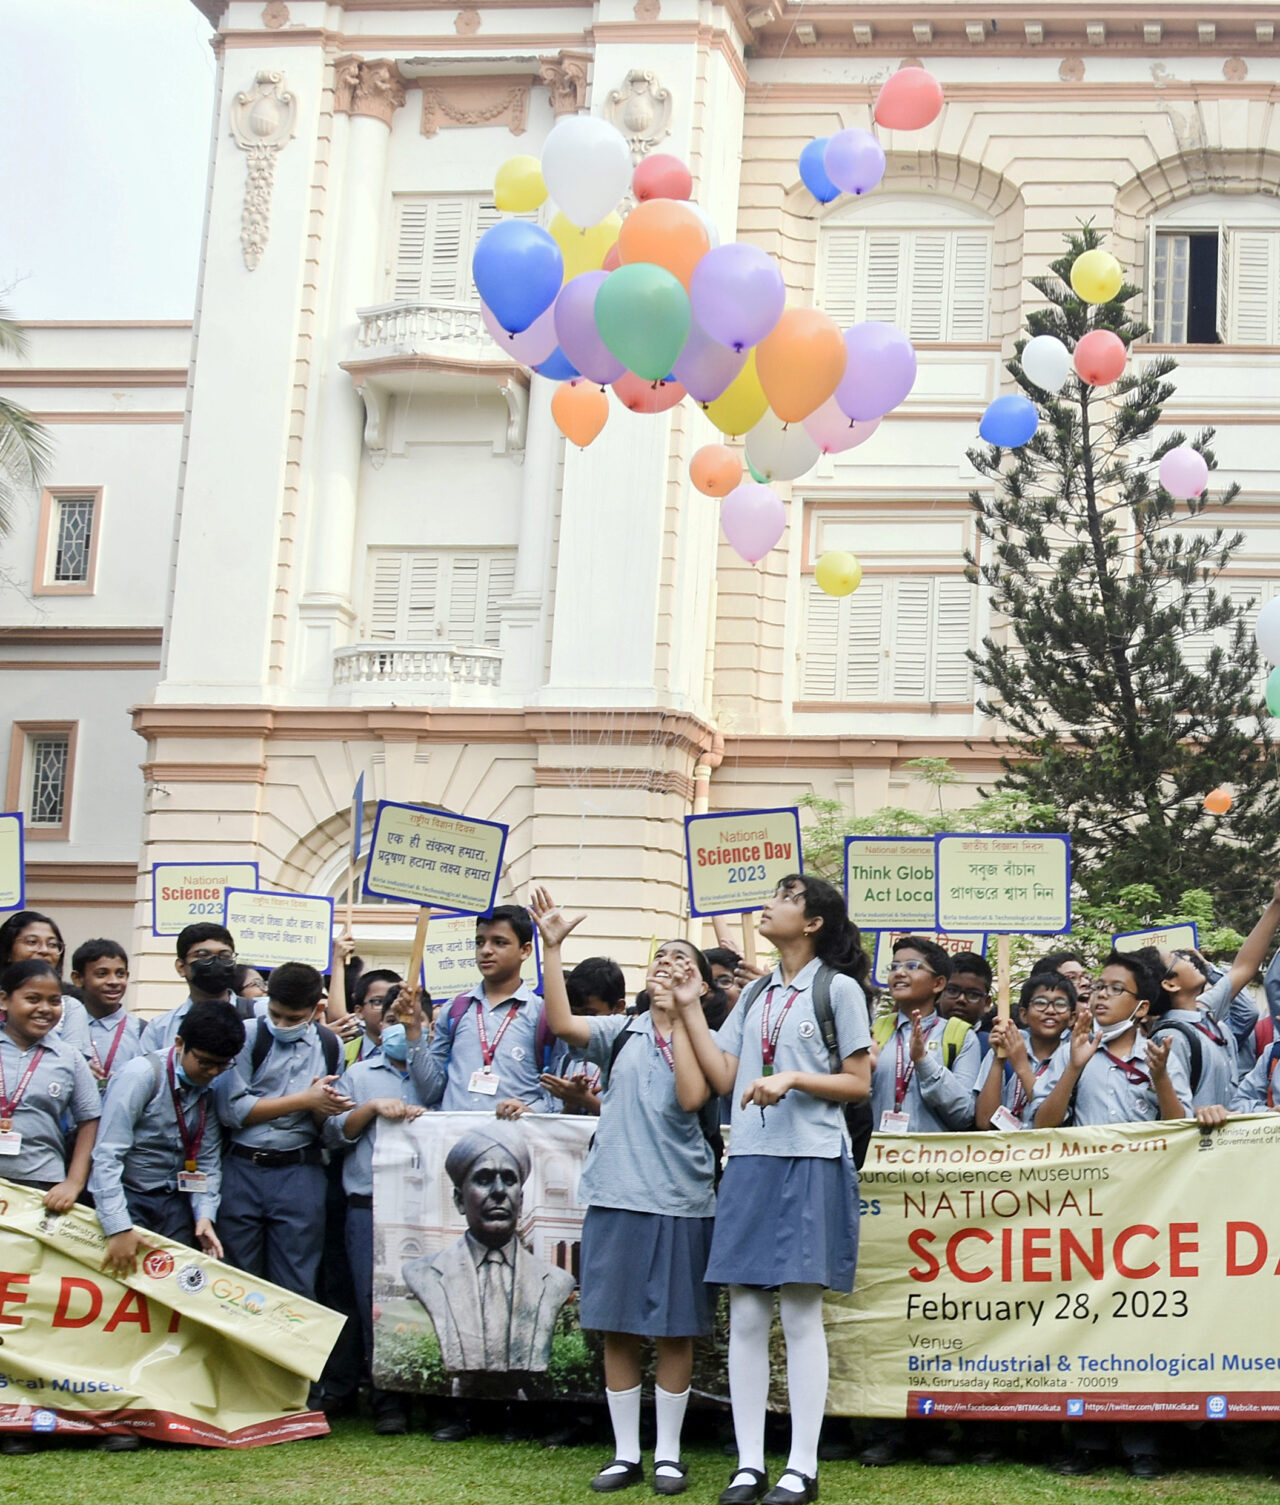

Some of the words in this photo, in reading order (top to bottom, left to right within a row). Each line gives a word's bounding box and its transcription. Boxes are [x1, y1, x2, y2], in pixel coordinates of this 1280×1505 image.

[455, 821, 476, 834] दिवस
[719, 827, 768, 843] National
[387, 832, 404, 844] एक
[409, 833, 421, 848] ही
[426, 838, 455, 855] संकल्प
[865, 846, 897, 854] National
[900, 846, 931, 854] Science
[697, 845, 760, 867] Science
[764, 841, 791, 860] Day
[378, 850, 406, 866] प्रदूषण
[409, 855, 436, 871] हटाना
[440, 862, 461, 875] लक्ष्य
[464, 867, 491, 881] हमारा
[728, 865, 766, 884] 2023
[852, 865, 892, 880] Think
[897, 865, 935, 880] Glob
[969, 863, 999, 881] সবুজ
[1004, 860, 1035, 876] বাঁচান
[184, 875, 228, 885] National
[162, 886, 220, 901] Science
[864, 888, 892, 901] Act
[896, 888, 933, 901] Loca
[950, 886, 999, 900] প্রাণভরে
[1004, 887, 1028, 900] শ্বাস
[1033, 882, 1055, 900] নিন
[188, 903, 225, 915] 2023
[1217, 1137, 1264, 1145] Government
[874, 1139, 1051, 1165] Technological
[912, 1168, 930, 1183] of
[936, 1168, 1012, 1184] Science
[1019, 1165, 1110, 1183] Museums
[903, 1187, 1103, 1219] NATIONAL
[908, 1224, 1199, 1283] SCIENCE
[906, 1293, 1044, 1326] February
[1055, 1293, 1099, 1324] 28,
[1111, 1290, 1189, 1319] 2023
[908, 1335, 963, 1350] Venue
[908, 1355, 952, 1372] Birla
[959, 1354, 1050, 1372] Industrial
[1057, 1356, 1072, 1371] &
[1078, 1353, 1215, 1376] Technological
[908, 1376, 930, 1388] 19A,
[932, 1377, 990, 1391] Gurusaday
[993, 1377, 1023, 1390] Road,
[1025, 1377, 1067, 1388] Kolkata
[1077, 1377, 1118, 1388] 700019
